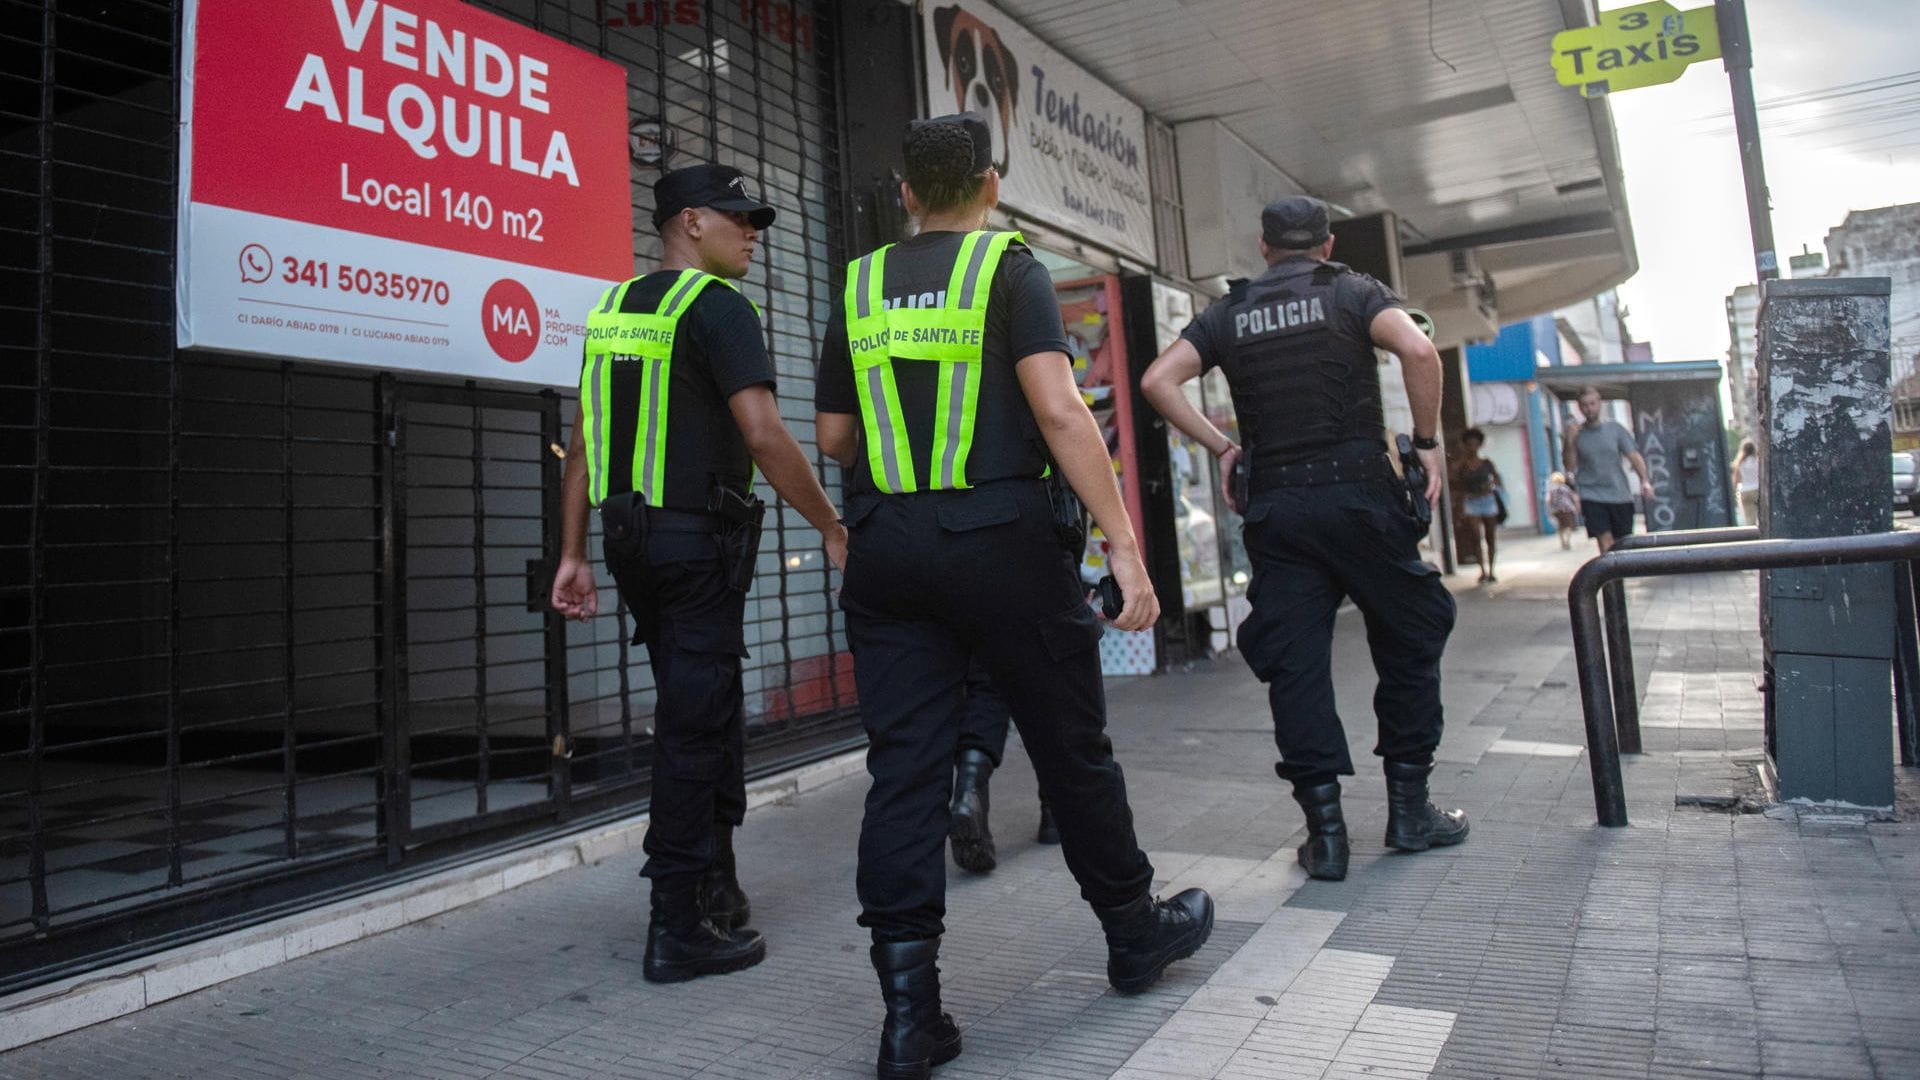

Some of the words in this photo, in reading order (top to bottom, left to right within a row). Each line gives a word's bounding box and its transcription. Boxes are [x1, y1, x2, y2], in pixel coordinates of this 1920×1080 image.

[1617, 11, 1650, 31] 3
[331, 0, 550, 114] VENDE
[1560, 33, 1700, 76] Taxis
[285, 52, 580, 187] ALQUILA
[1031, 64, 1139, 175] Tentación
[341, 162, 431, 218] Local
[440, 187, 494, 230] 140
[502, 208, 544, 242] m2
[282, 256, 328, 288] 341
[337, 265, 450, 306] 5035970
[237, 313, 248, 324] CI
[251, 314, 283, 328] DARÍO
[286, 319, 317, 332] ABIAD
[352, 327, 362, 337] CI
[363, 328, 402, 342] LUCIANO
[404, 332, 431, 345] ABIAD
[492, 303, 533, 337] MA
[545, 308, 560, 320] MA
[1235, 297, 1325, 338] POLICIA
[620, 329, 630, 339] DE
[630, 326, 659, 343] SANTA
[660, 330, 672, 345] FE
[893, 330, 909, 342] DE
[911, 327, 958, 345] SANTA
[961, 329, 980, 346] FE
